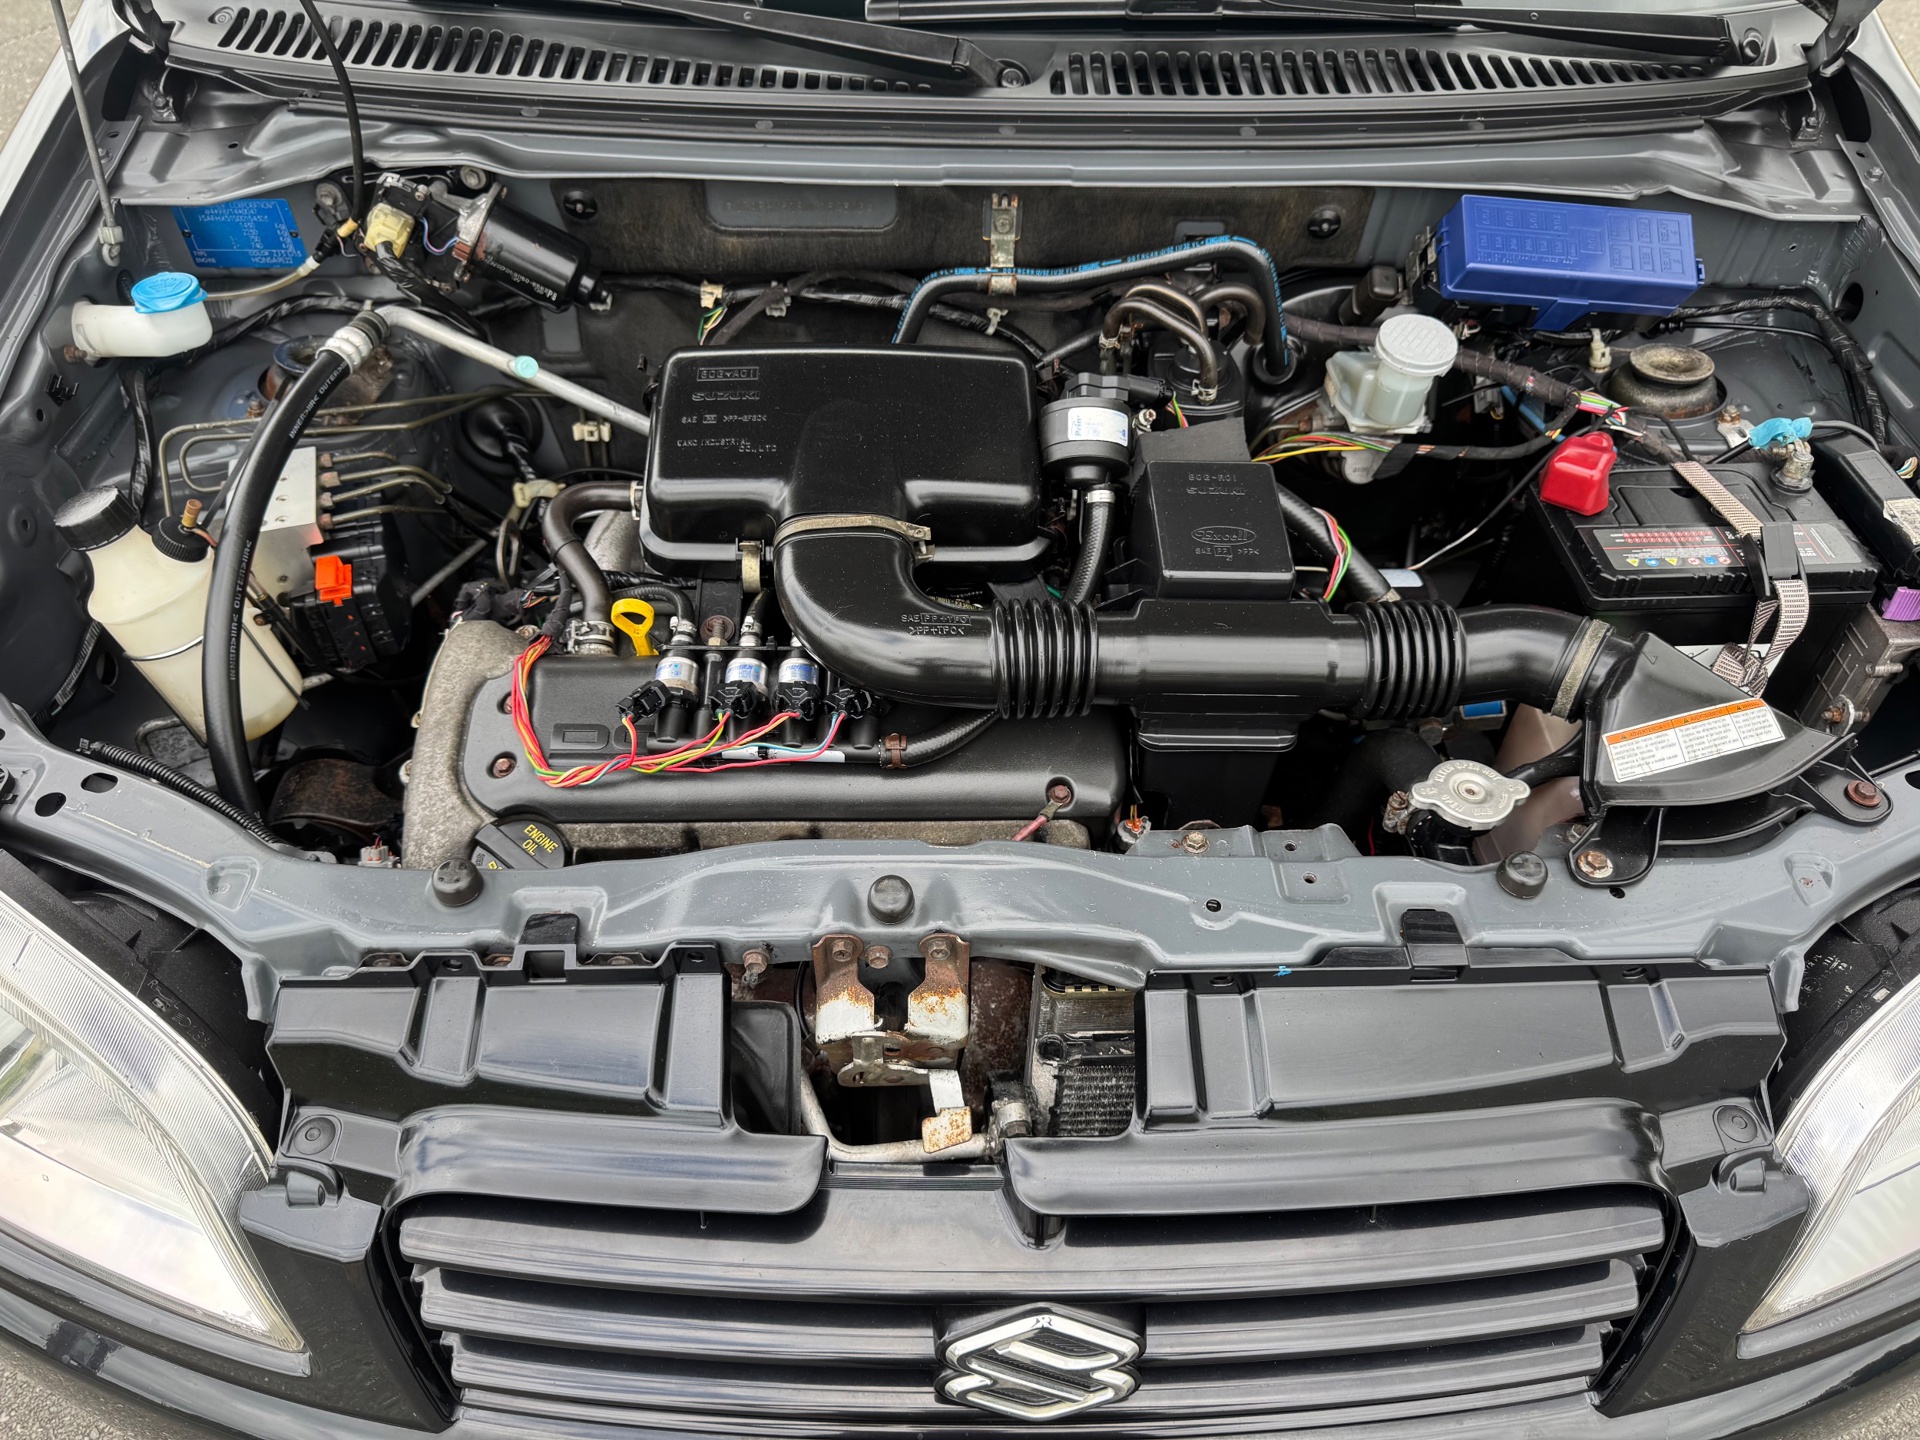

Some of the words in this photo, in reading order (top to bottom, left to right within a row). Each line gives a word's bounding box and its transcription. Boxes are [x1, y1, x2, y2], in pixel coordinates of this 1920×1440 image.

[692, 391, 761, 401] SUZUKI
[1186, 487, 1245, 495] SUZUKI
[901, 614, 920, 622] SAE
[524, 824, 559, 854] ENGINE
[522, 840, 536, 856] OIL
